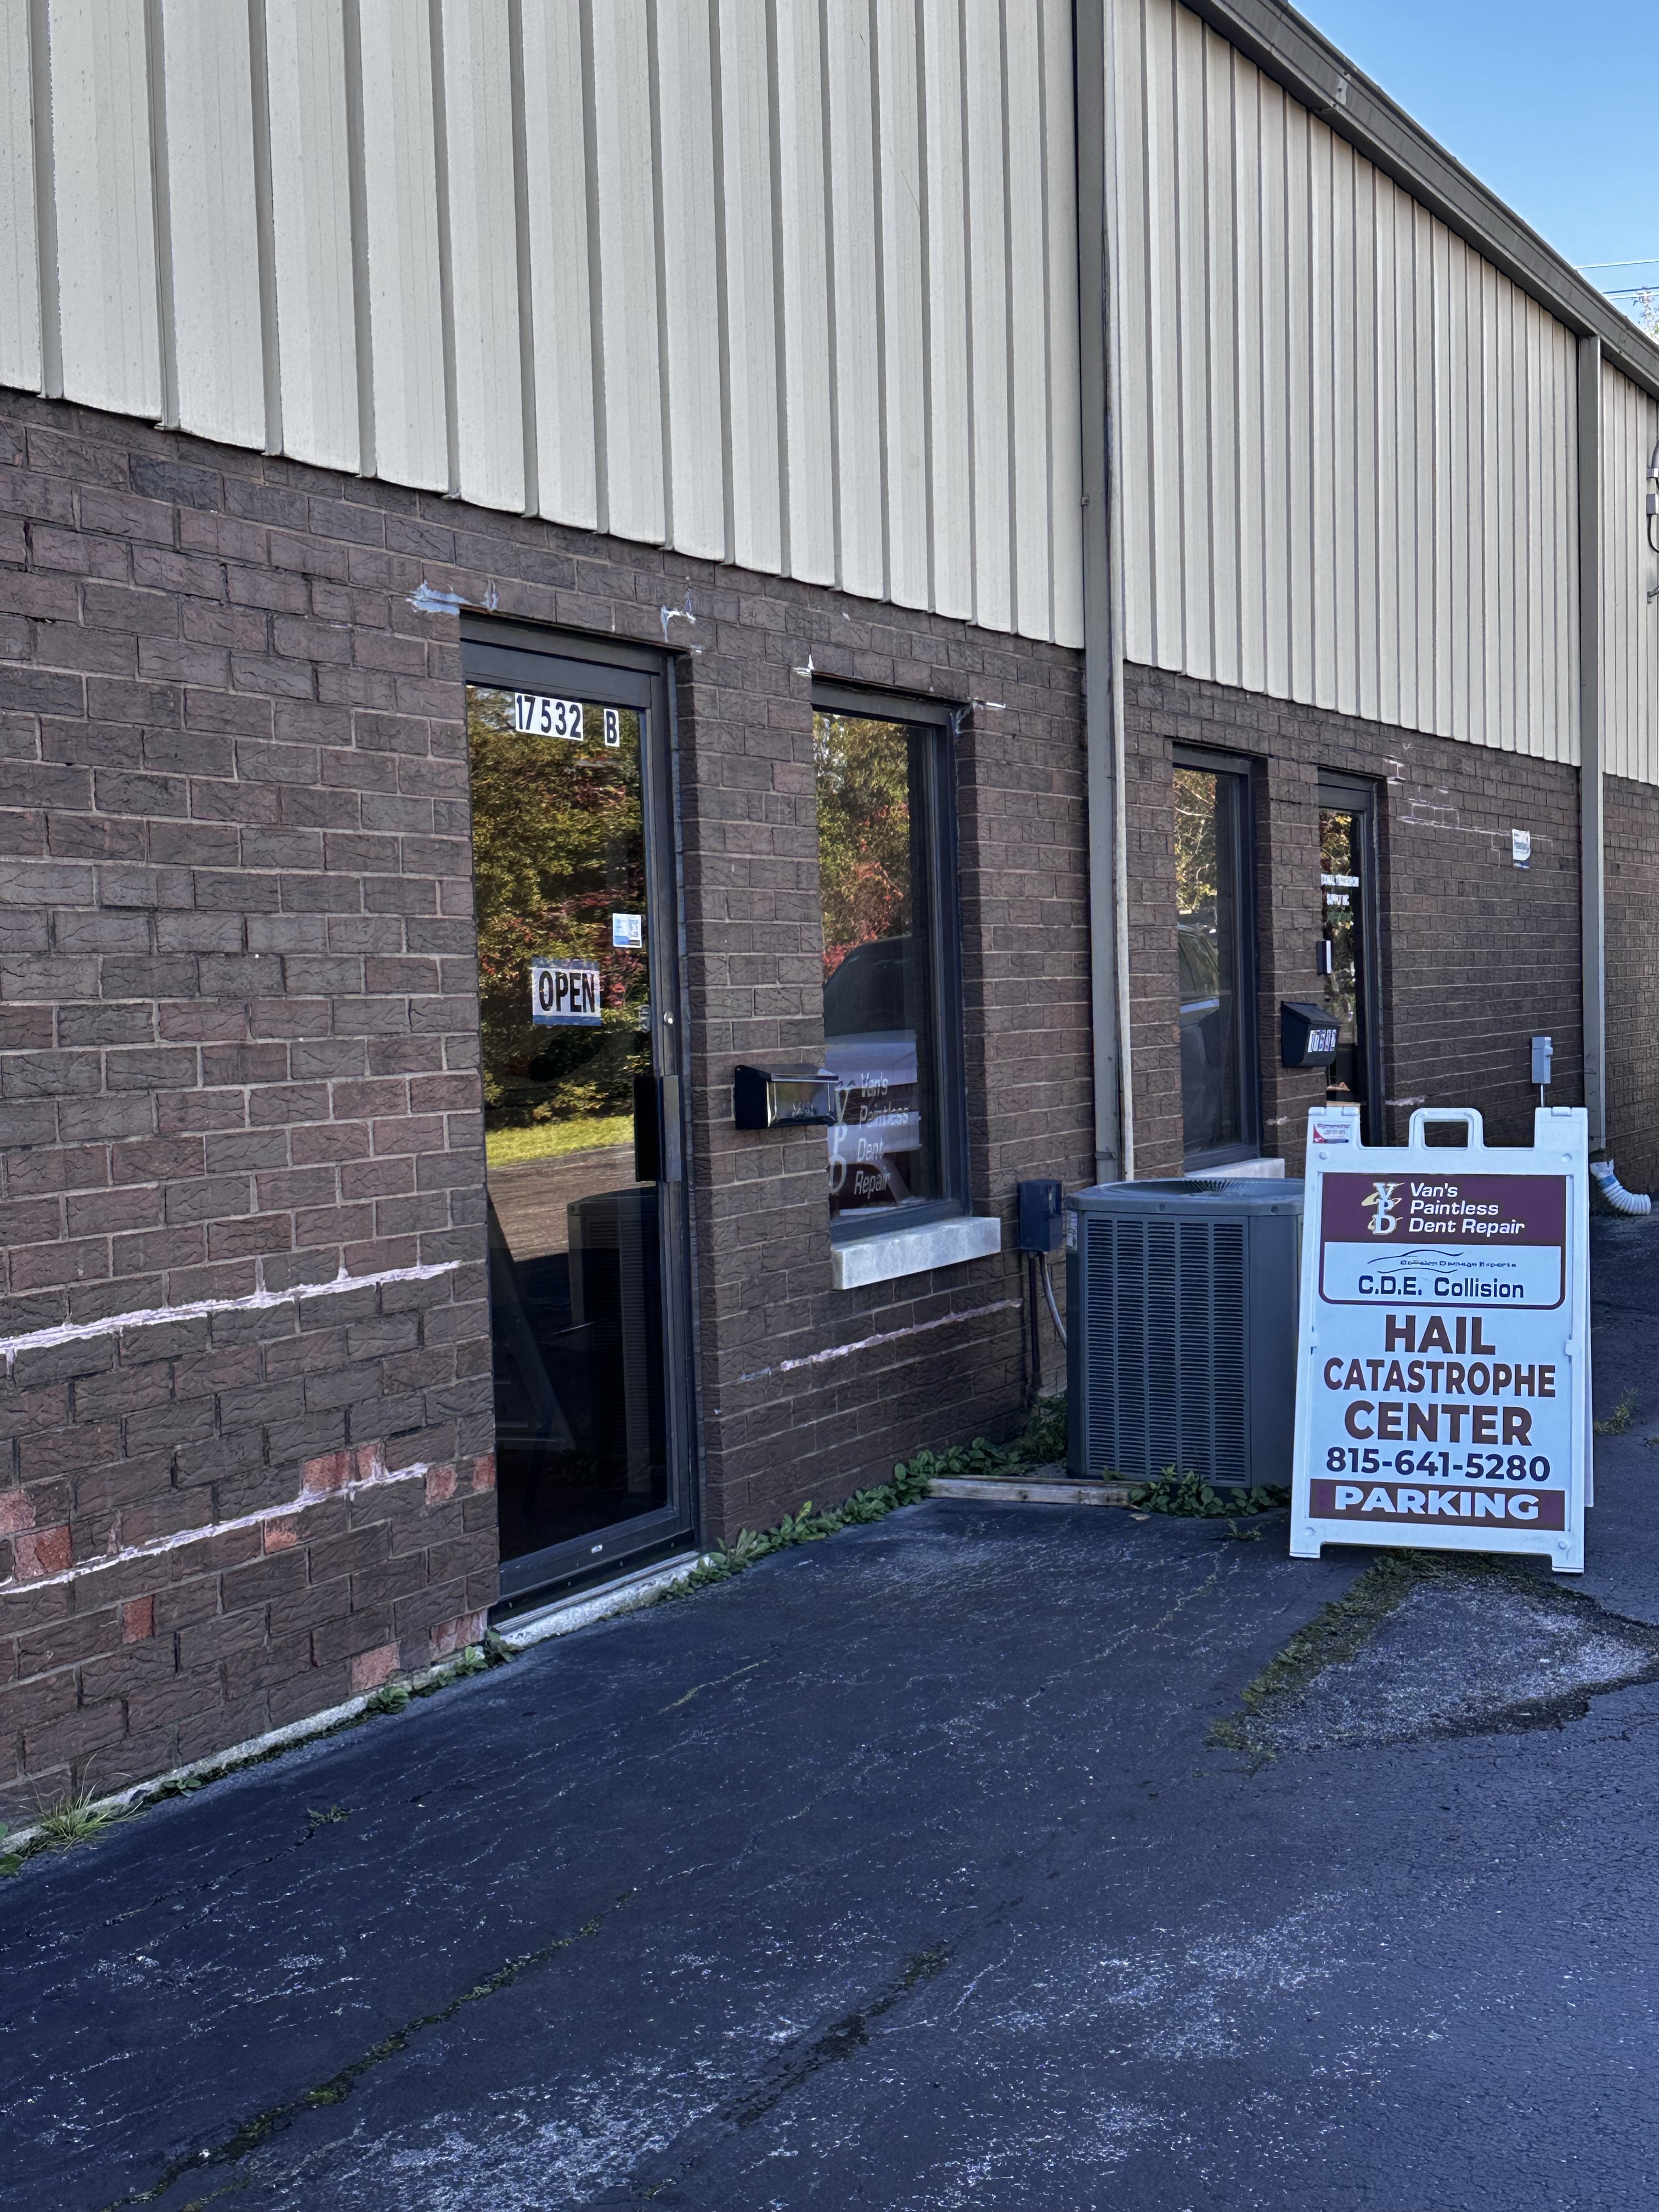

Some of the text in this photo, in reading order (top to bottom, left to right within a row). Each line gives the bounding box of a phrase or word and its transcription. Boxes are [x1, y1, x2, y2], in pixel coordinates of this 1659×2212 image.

[517, 695, 617, 744] 17532 B
[538, 970, 596, 1013] OPEN
[856, 1137, 884, 1163] Dent
[854, 1166, 891, 1200] Repair
[1410, 1182, 1458, 1197] Van's
[1410, 1200, 1499, 1215] Paintless
[1409, 1217, 1525, 1237] Dent Repair
[1358, 1276, 1525, 1298] C.D.E. Collision
[1385, 1314, 1496, 1355] HAIL
[1324, 1357, 1556, 1398] CATASTROPHE
[1345, 1400, 1533, 1446] CENTER
[1327, 1447, 1550, 1482] 815-641-5280
[1335, 1485, 1539, 1520] PARKING
